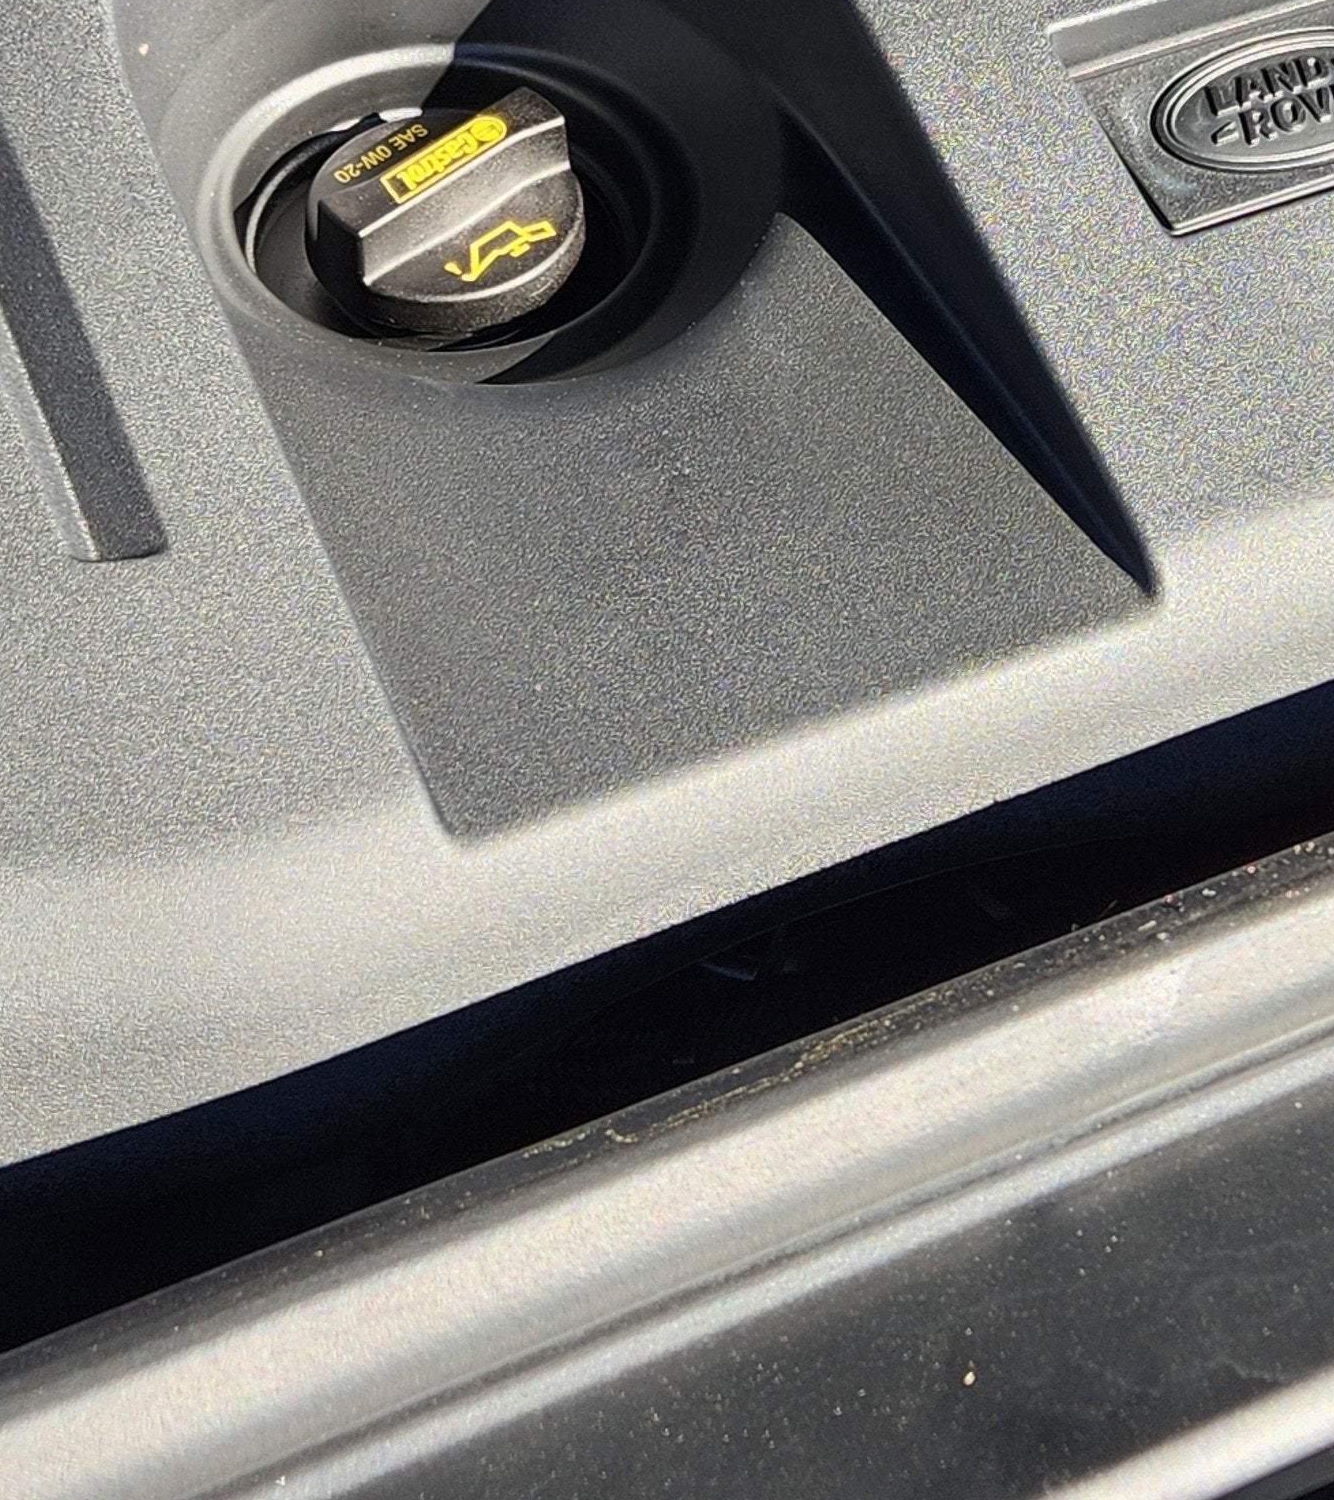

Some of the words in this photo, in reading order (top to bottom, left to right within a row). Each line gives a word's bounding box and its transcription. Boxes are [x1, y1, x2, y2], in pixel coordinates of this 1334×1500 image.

[1203, 55, 1331, 117] LAND
[388, 124, 429, 150] SAE
[396, 131, 479, 191] Castrol
[333, 144, 393, 184] 0W-20
